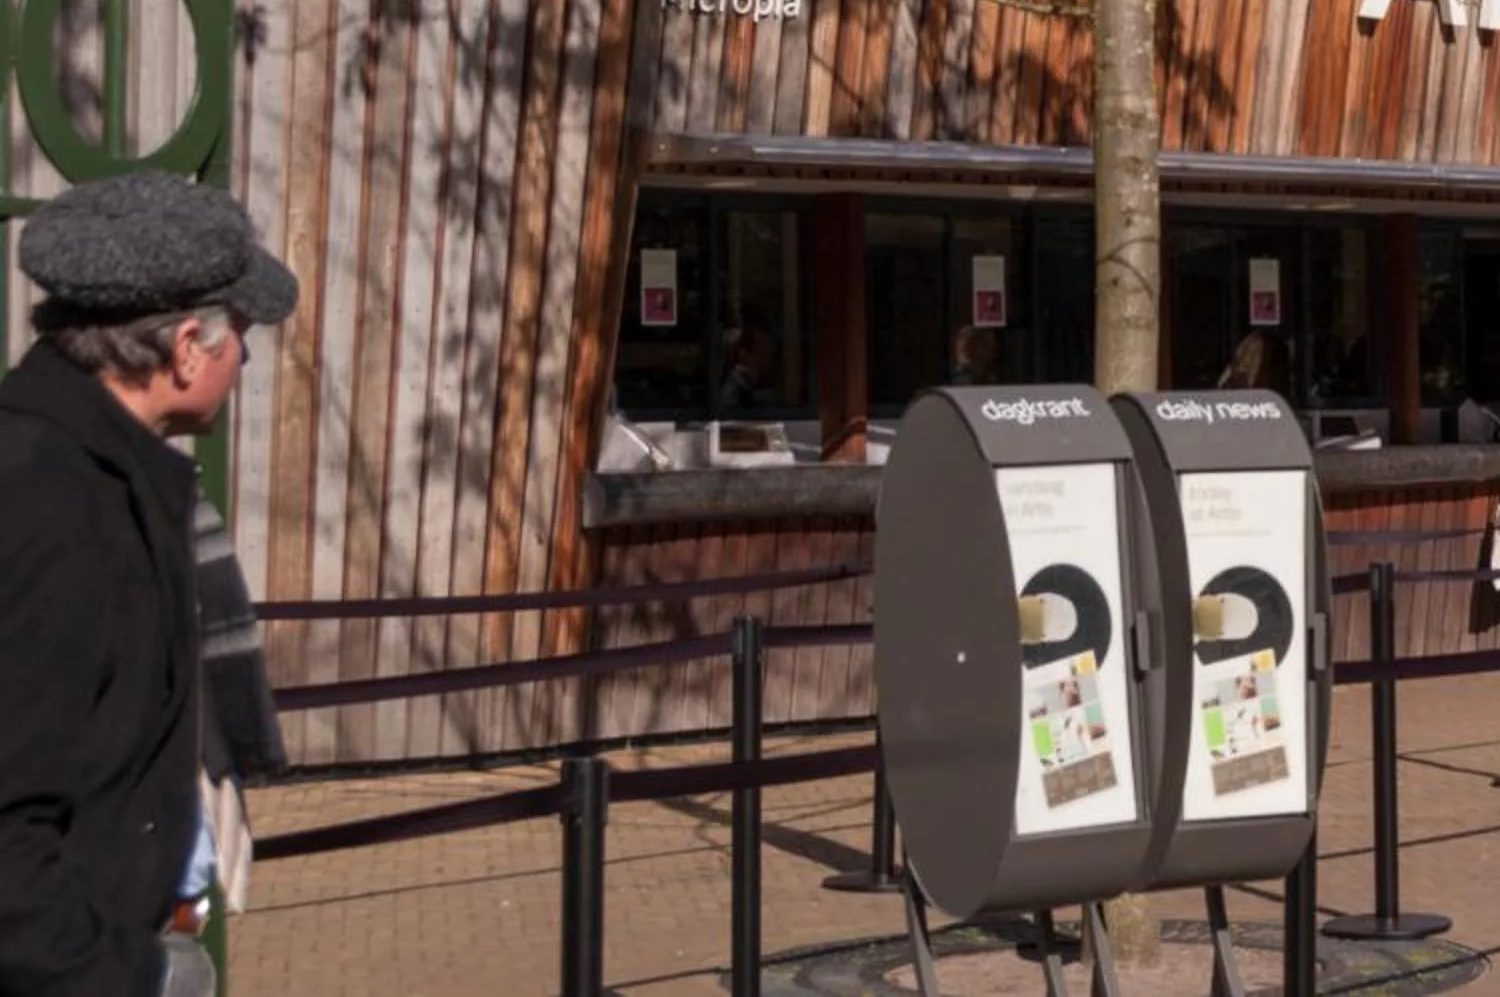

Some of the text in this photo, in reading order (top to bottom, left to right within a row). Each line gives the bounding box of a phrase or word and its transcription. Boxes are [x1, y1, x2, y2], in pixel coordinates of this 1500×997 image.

[982, 397, 1092, 425] dagkrant
[1156, 400, 1282, 423] daily news
